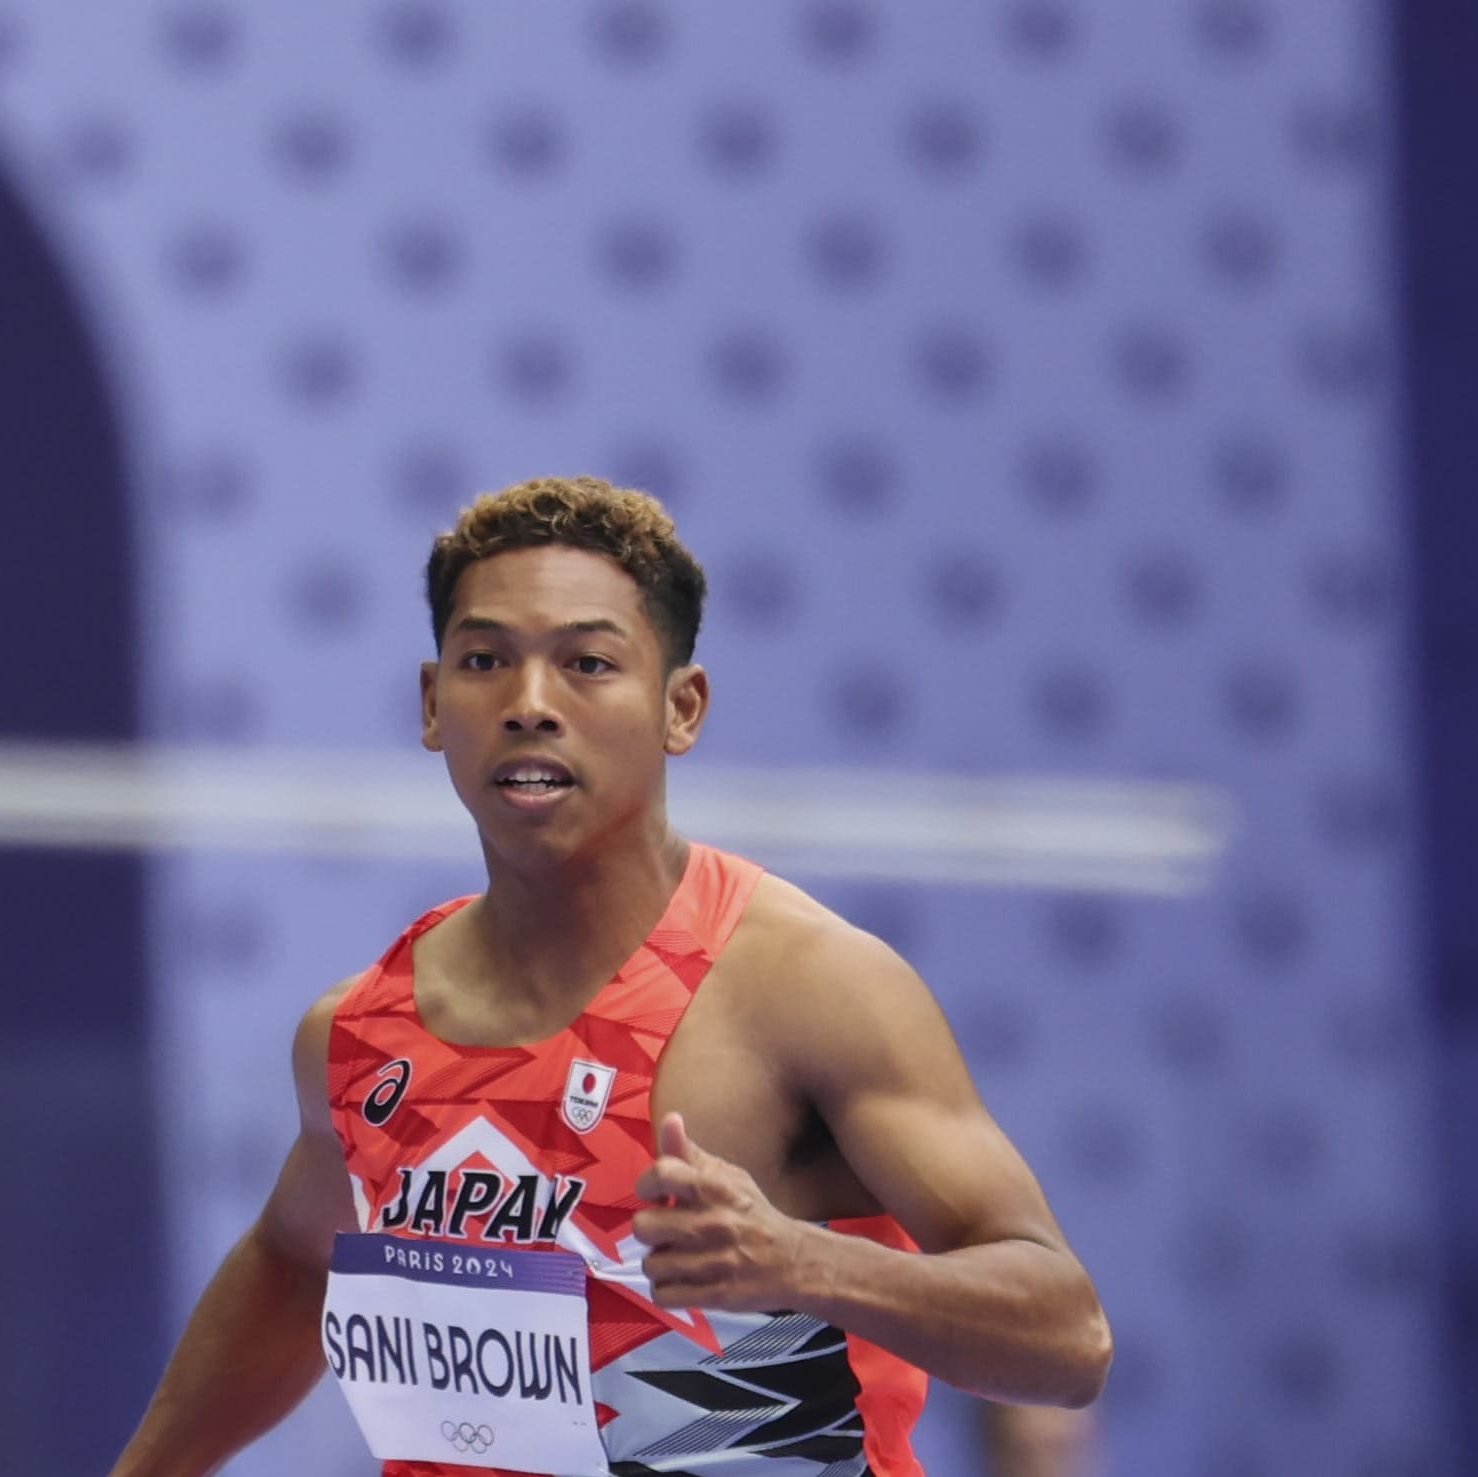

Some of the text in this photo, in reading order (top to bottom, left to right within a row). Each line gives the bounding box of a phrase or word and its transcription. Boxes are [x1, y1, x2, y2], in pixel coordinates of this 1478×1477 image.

[384, 1245, 514, 1279] PARIS 2024
[324, 1311, 583, 1406] SANI BROWN
